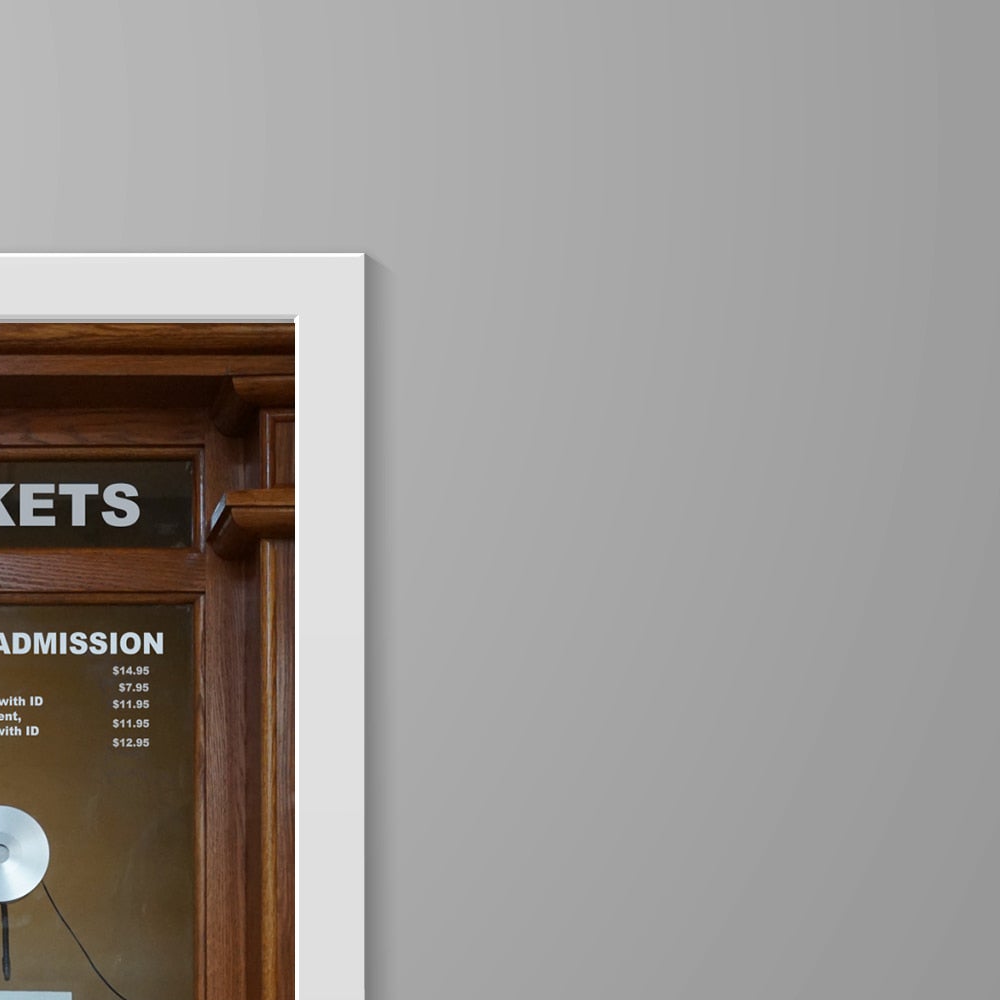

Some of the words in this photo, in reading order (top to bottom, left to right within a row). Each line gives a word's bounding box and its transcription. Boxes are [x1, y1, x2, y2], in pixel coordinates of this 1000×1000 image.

[113, 666, 149, 675] $14.95
[119, 683, 149, 692] $7.95
[30, 696, 43, 706] ID
[113, 700, 149, 709] $11.95
[113, 719, 149, 728] $11.95
[26, 726, 39, 736] ID
[113, 738, 149, 747] $12.95
